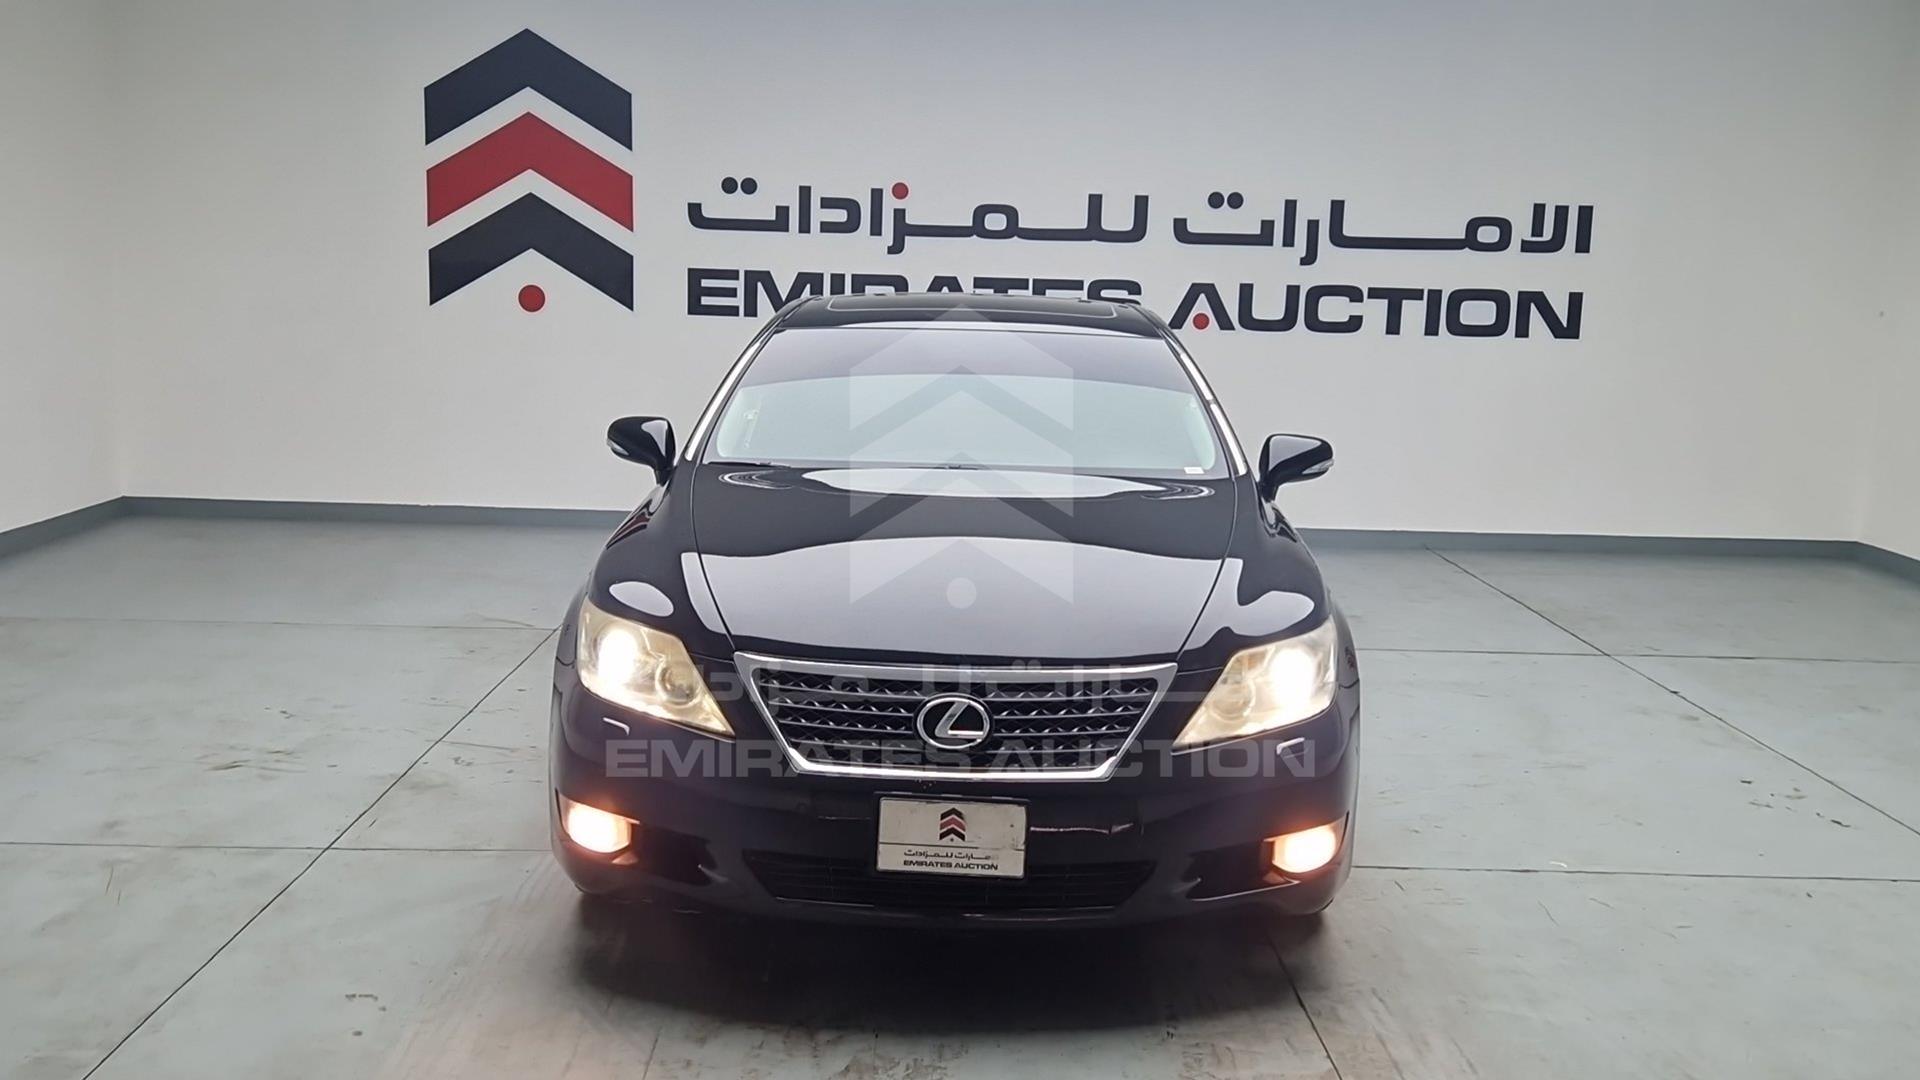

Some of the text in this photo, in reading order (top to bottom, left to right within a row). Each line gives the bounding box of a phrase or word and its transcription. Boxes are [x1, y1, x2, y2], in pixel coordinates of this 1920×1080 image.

[687, 176, 1595, 267] الامارات للمزادات
[1167, 282, 1584, 340] AUCTION
[903, 860, 999, 871] EMIRATES AUCTION
